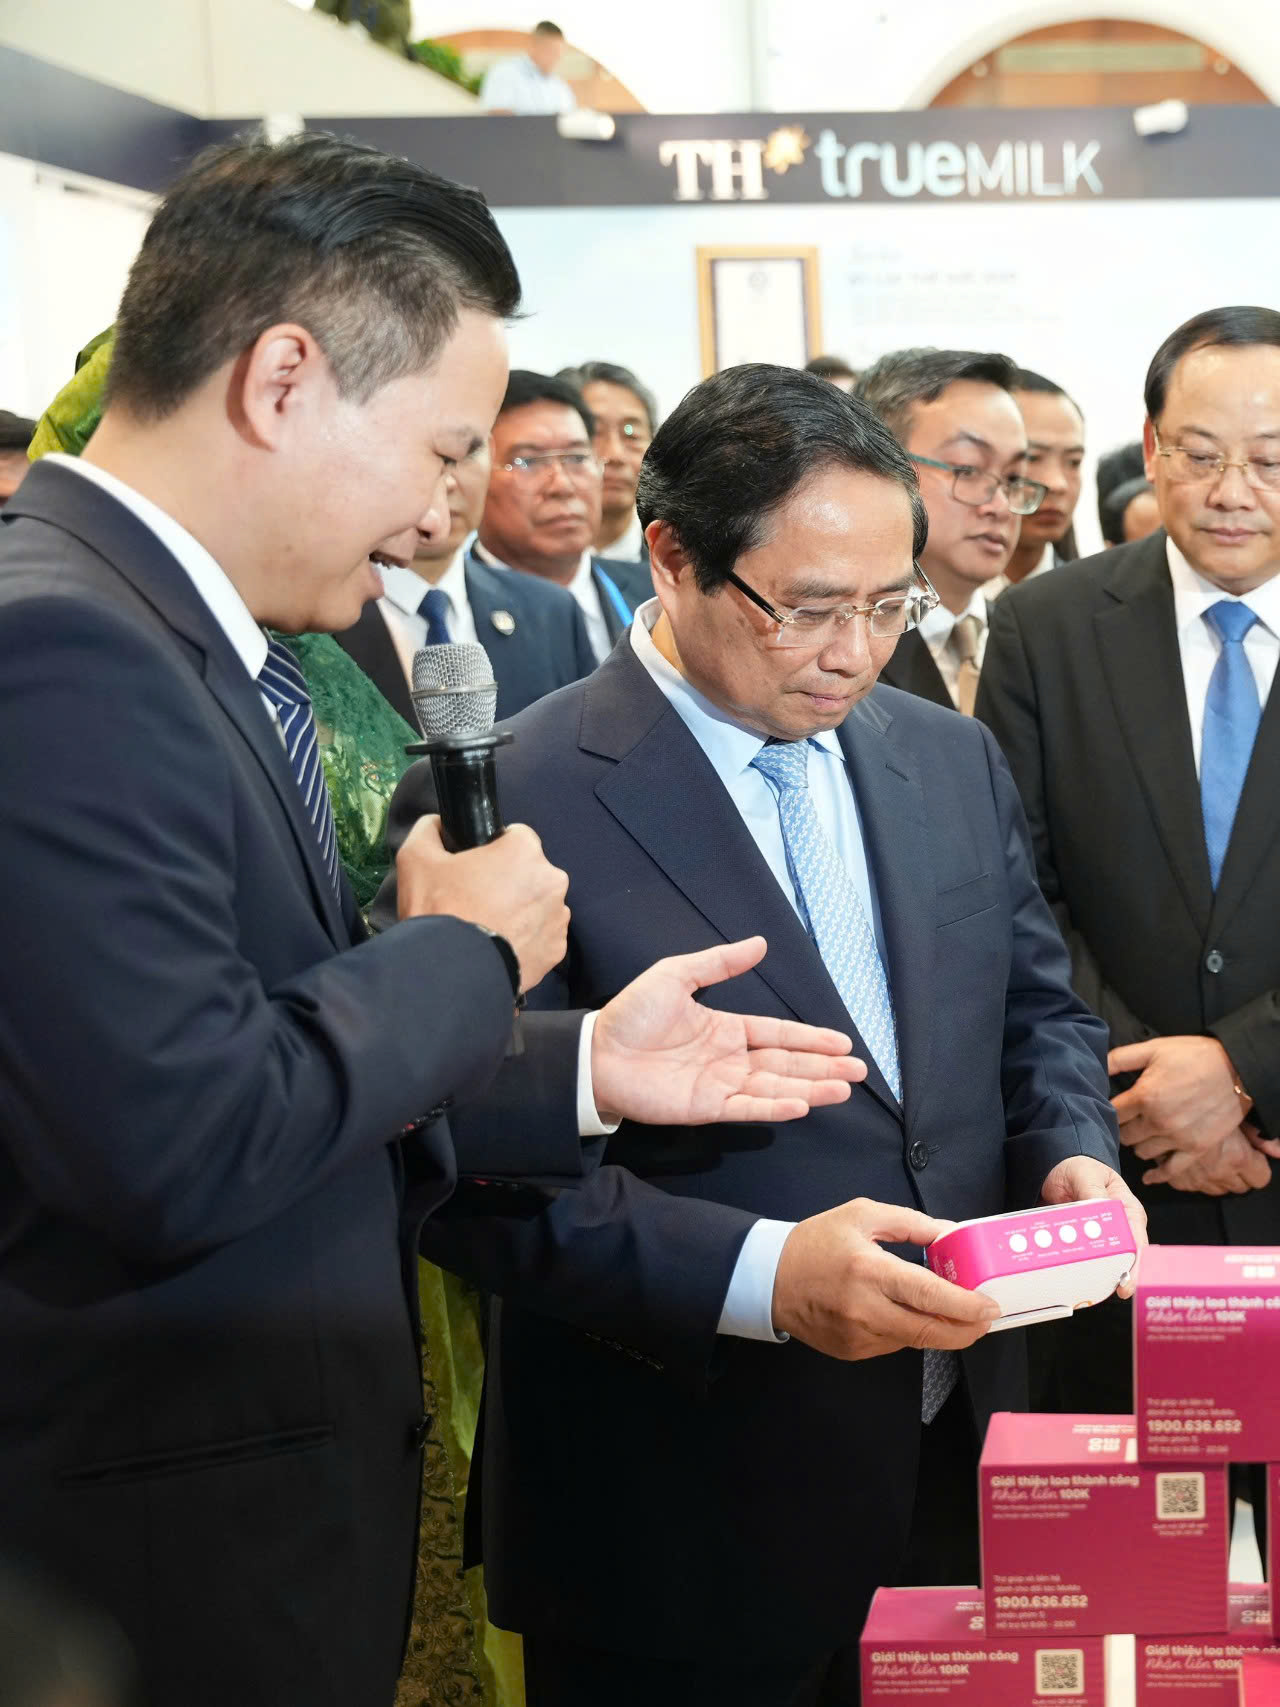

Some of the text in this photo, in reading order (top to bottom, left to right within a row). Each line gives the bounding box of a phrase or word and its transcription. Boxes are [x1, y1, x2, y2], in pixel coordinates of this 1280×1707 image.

[659, 139, 769, 200] TH
[1148, 1419, 1242, 1433] 1900.636.652
[1060, 1488, 1090, 1499] 100K
[995, 1595, 1088, 1608] 1900.636.652
[1204, 1646, 1223, 1655] loa
[931, 1652, 950, 1661] loa
[940, 1664, 969, 1674] 100K
